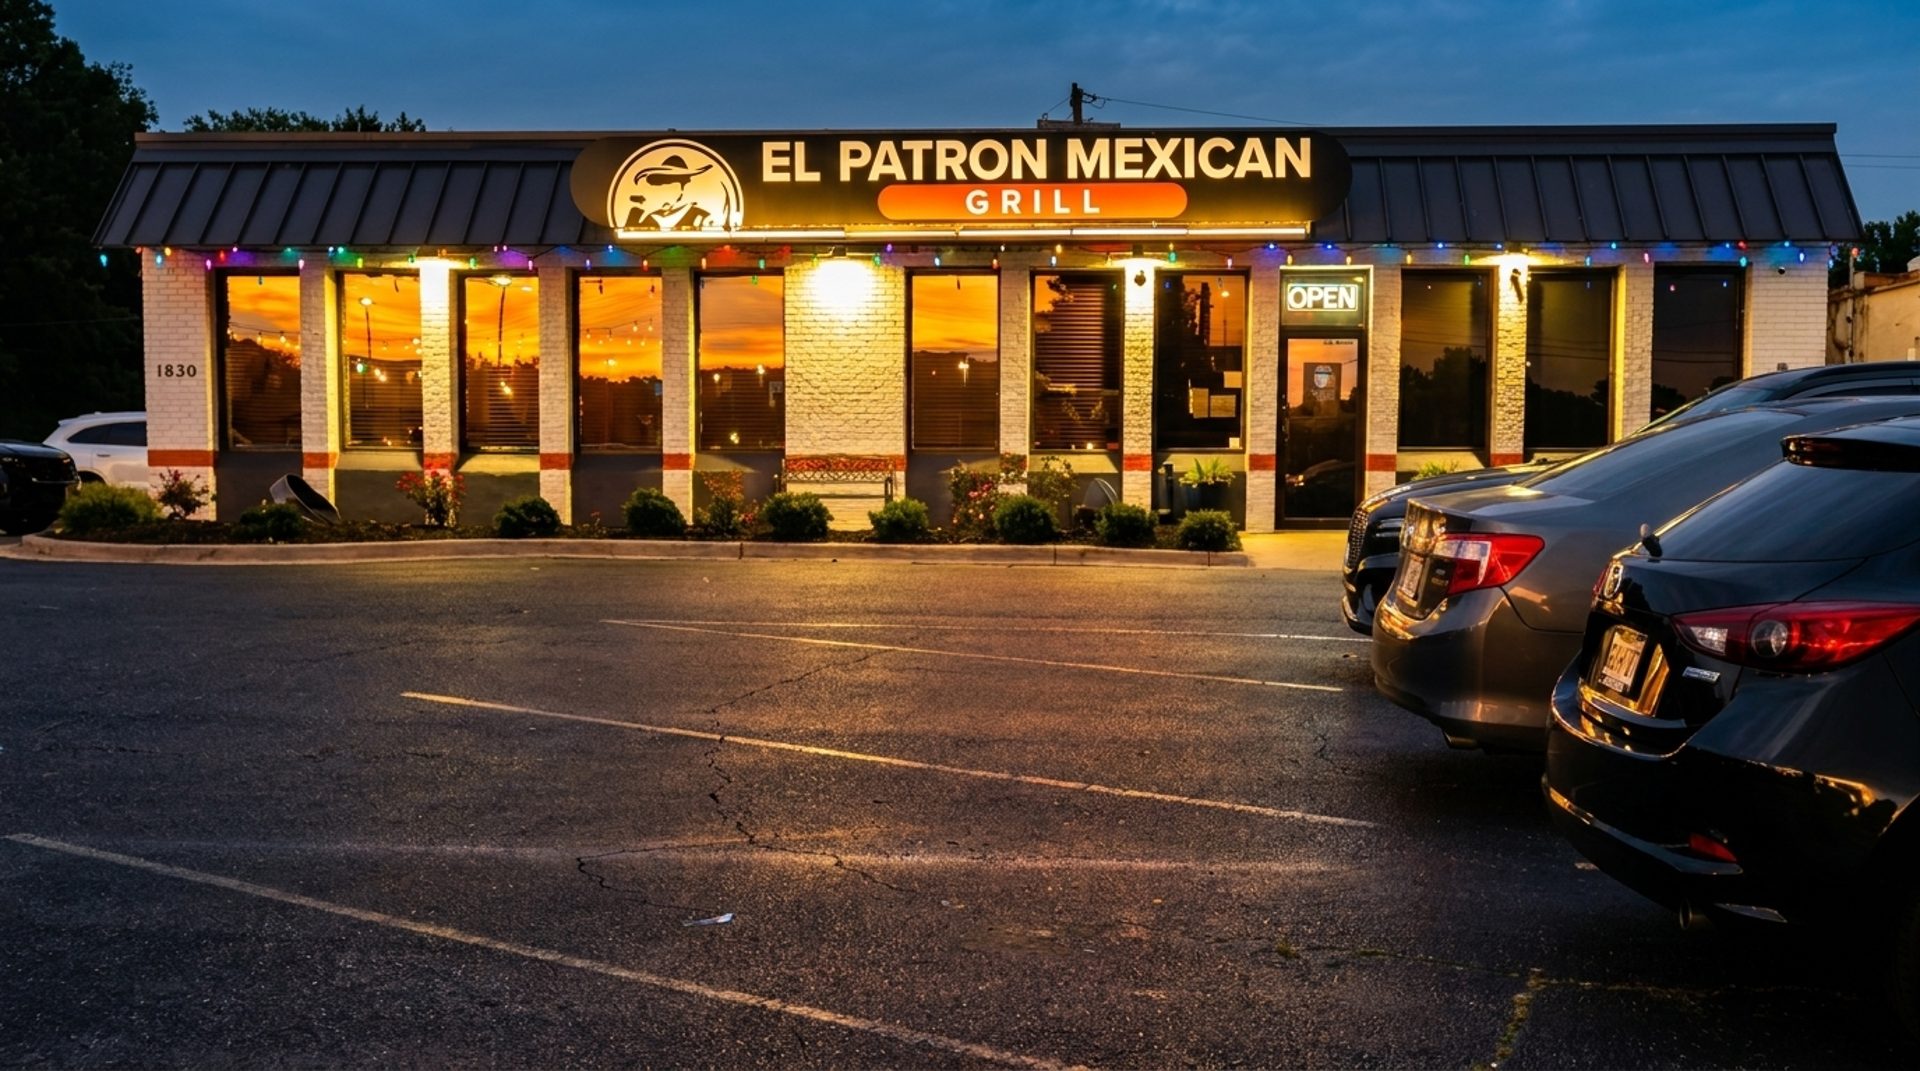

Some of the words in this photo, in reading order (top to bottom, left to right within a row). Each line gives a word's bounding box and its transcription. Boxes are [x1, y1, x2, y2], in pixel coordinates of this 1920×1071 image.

[762, 141, 821, 182] EL
[840, 139, 1047, 182] PATRON
[1068, 137, 1311, 180] MEXICAN
[965, 189, 1101, 215] GRILL
[1287, 286, 1357, 309] OPEN
[157, 364, 197, 377] 1830
